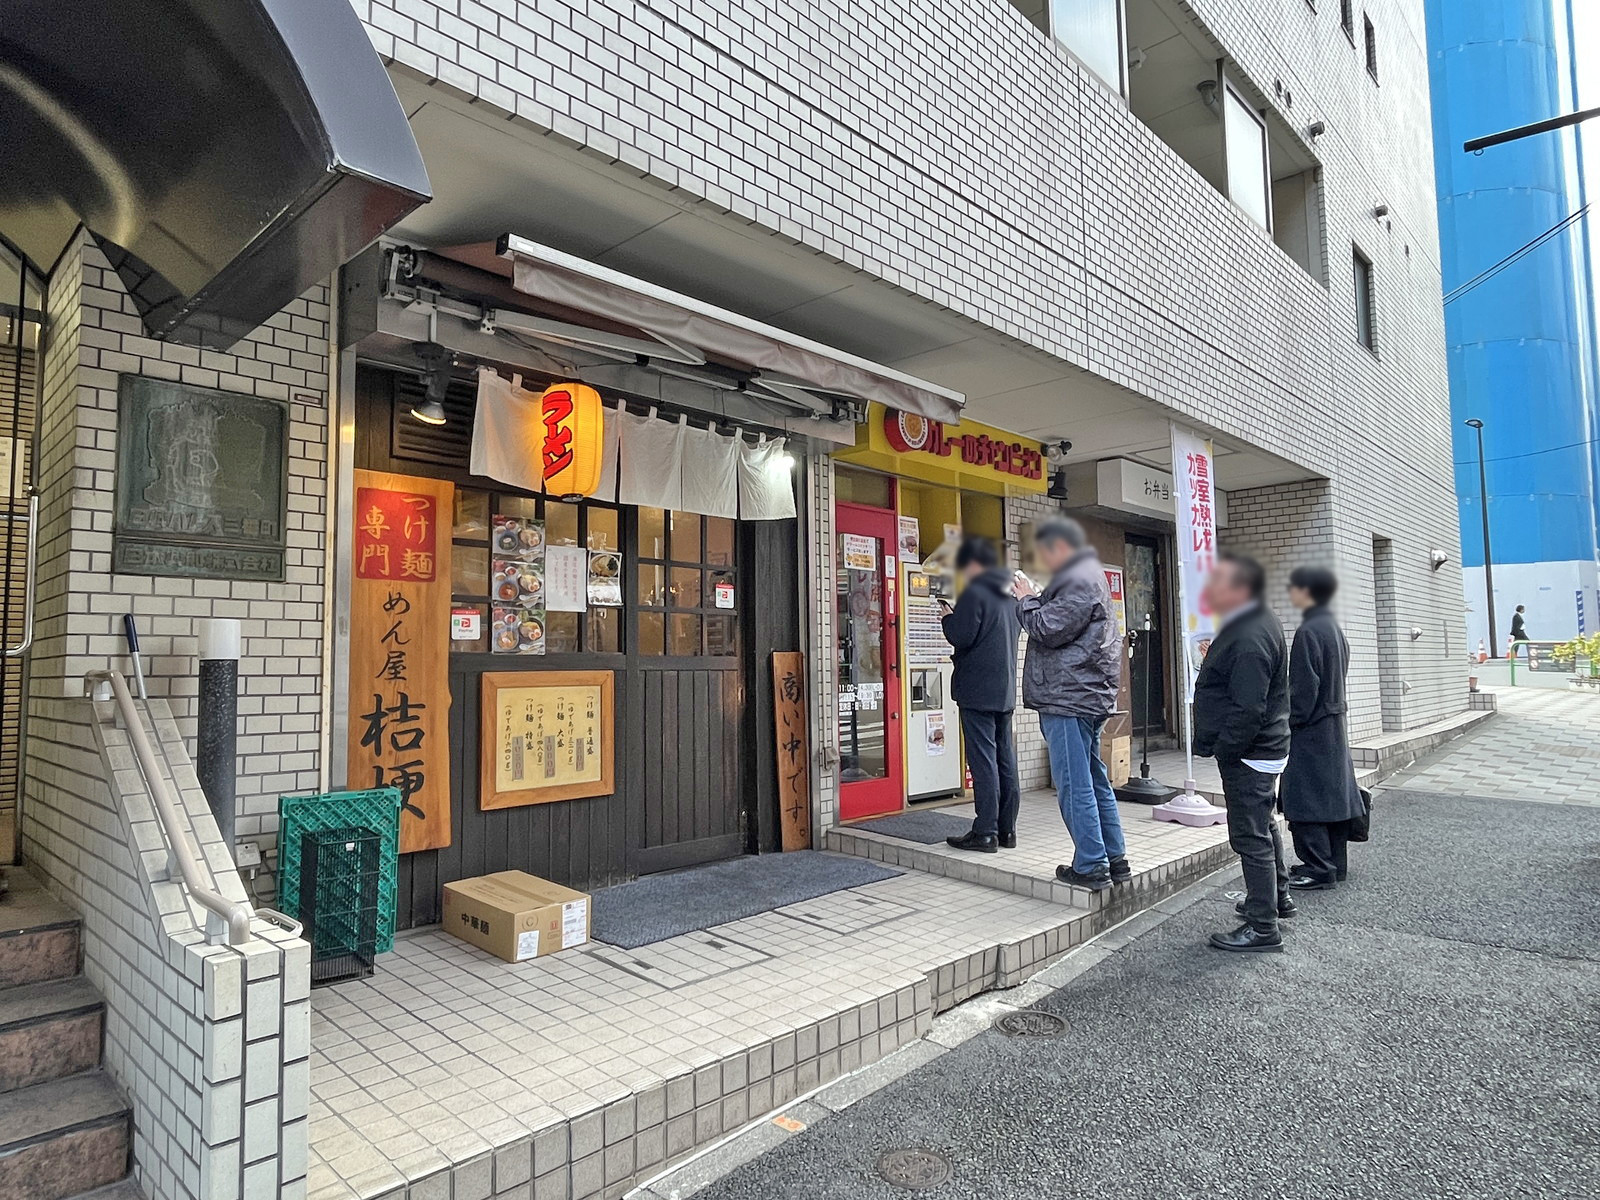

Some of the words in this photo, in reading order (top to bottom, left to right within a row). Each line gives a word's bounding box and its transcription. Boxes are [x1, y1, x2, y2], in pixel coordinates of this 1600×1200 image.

[542, 390, 573, 481] ラーメン
[1144, 479, 1169, 500] お弁当
[1196, 454, 1213, 574] 雪室熟成
[359, 505, 391, 577] 専門
[400, 495, 433, 579] つけ麺
[461, 913, 490, 936] 中華麺
